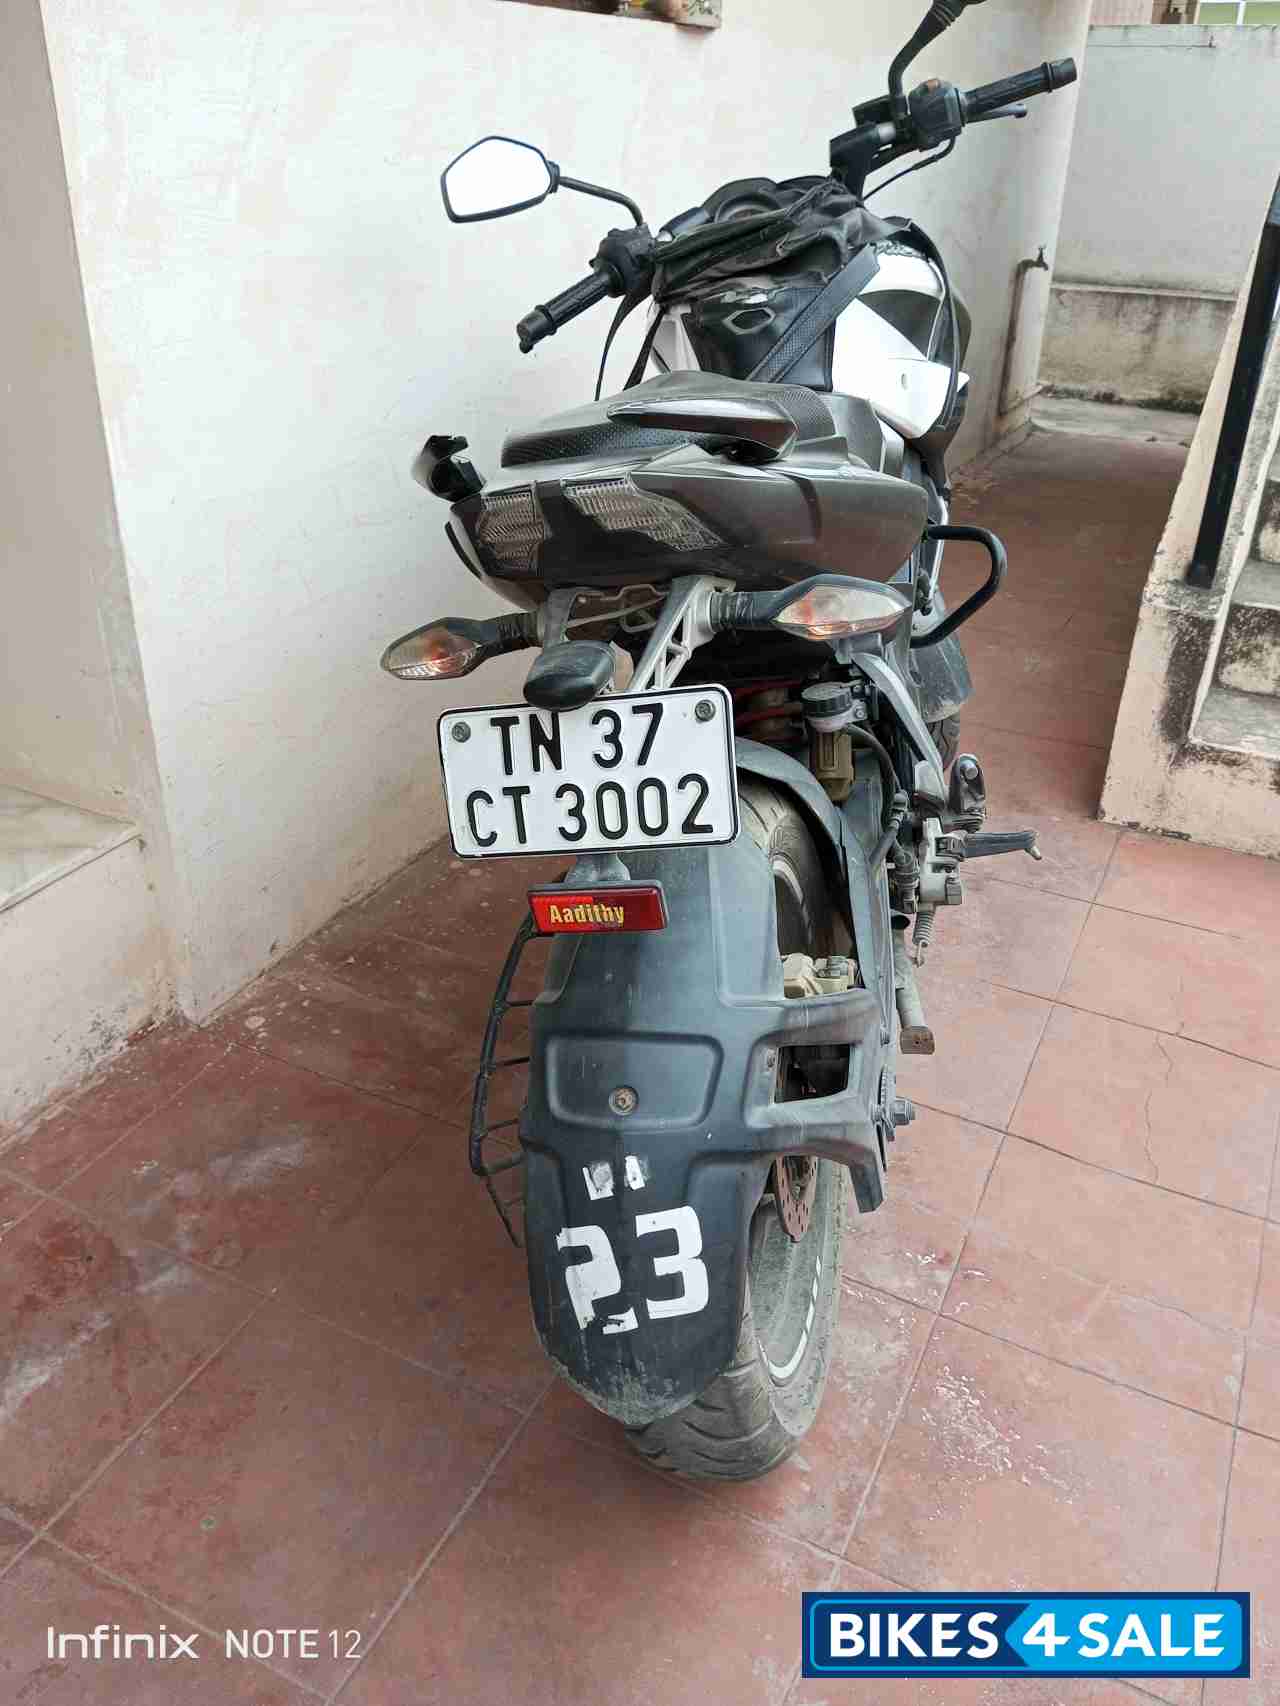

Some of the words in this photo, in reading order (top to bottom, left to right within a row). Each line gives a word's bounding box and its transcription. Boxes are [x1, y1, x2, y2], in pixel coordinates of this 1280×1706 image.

[490, 711, 563, 776] TN
[591, 703, 664, 769] 37
[466, 785, 530, 847] CT
[555, 773, 713, 842] 3002
[550, 903, 625, 928] Aadithy
